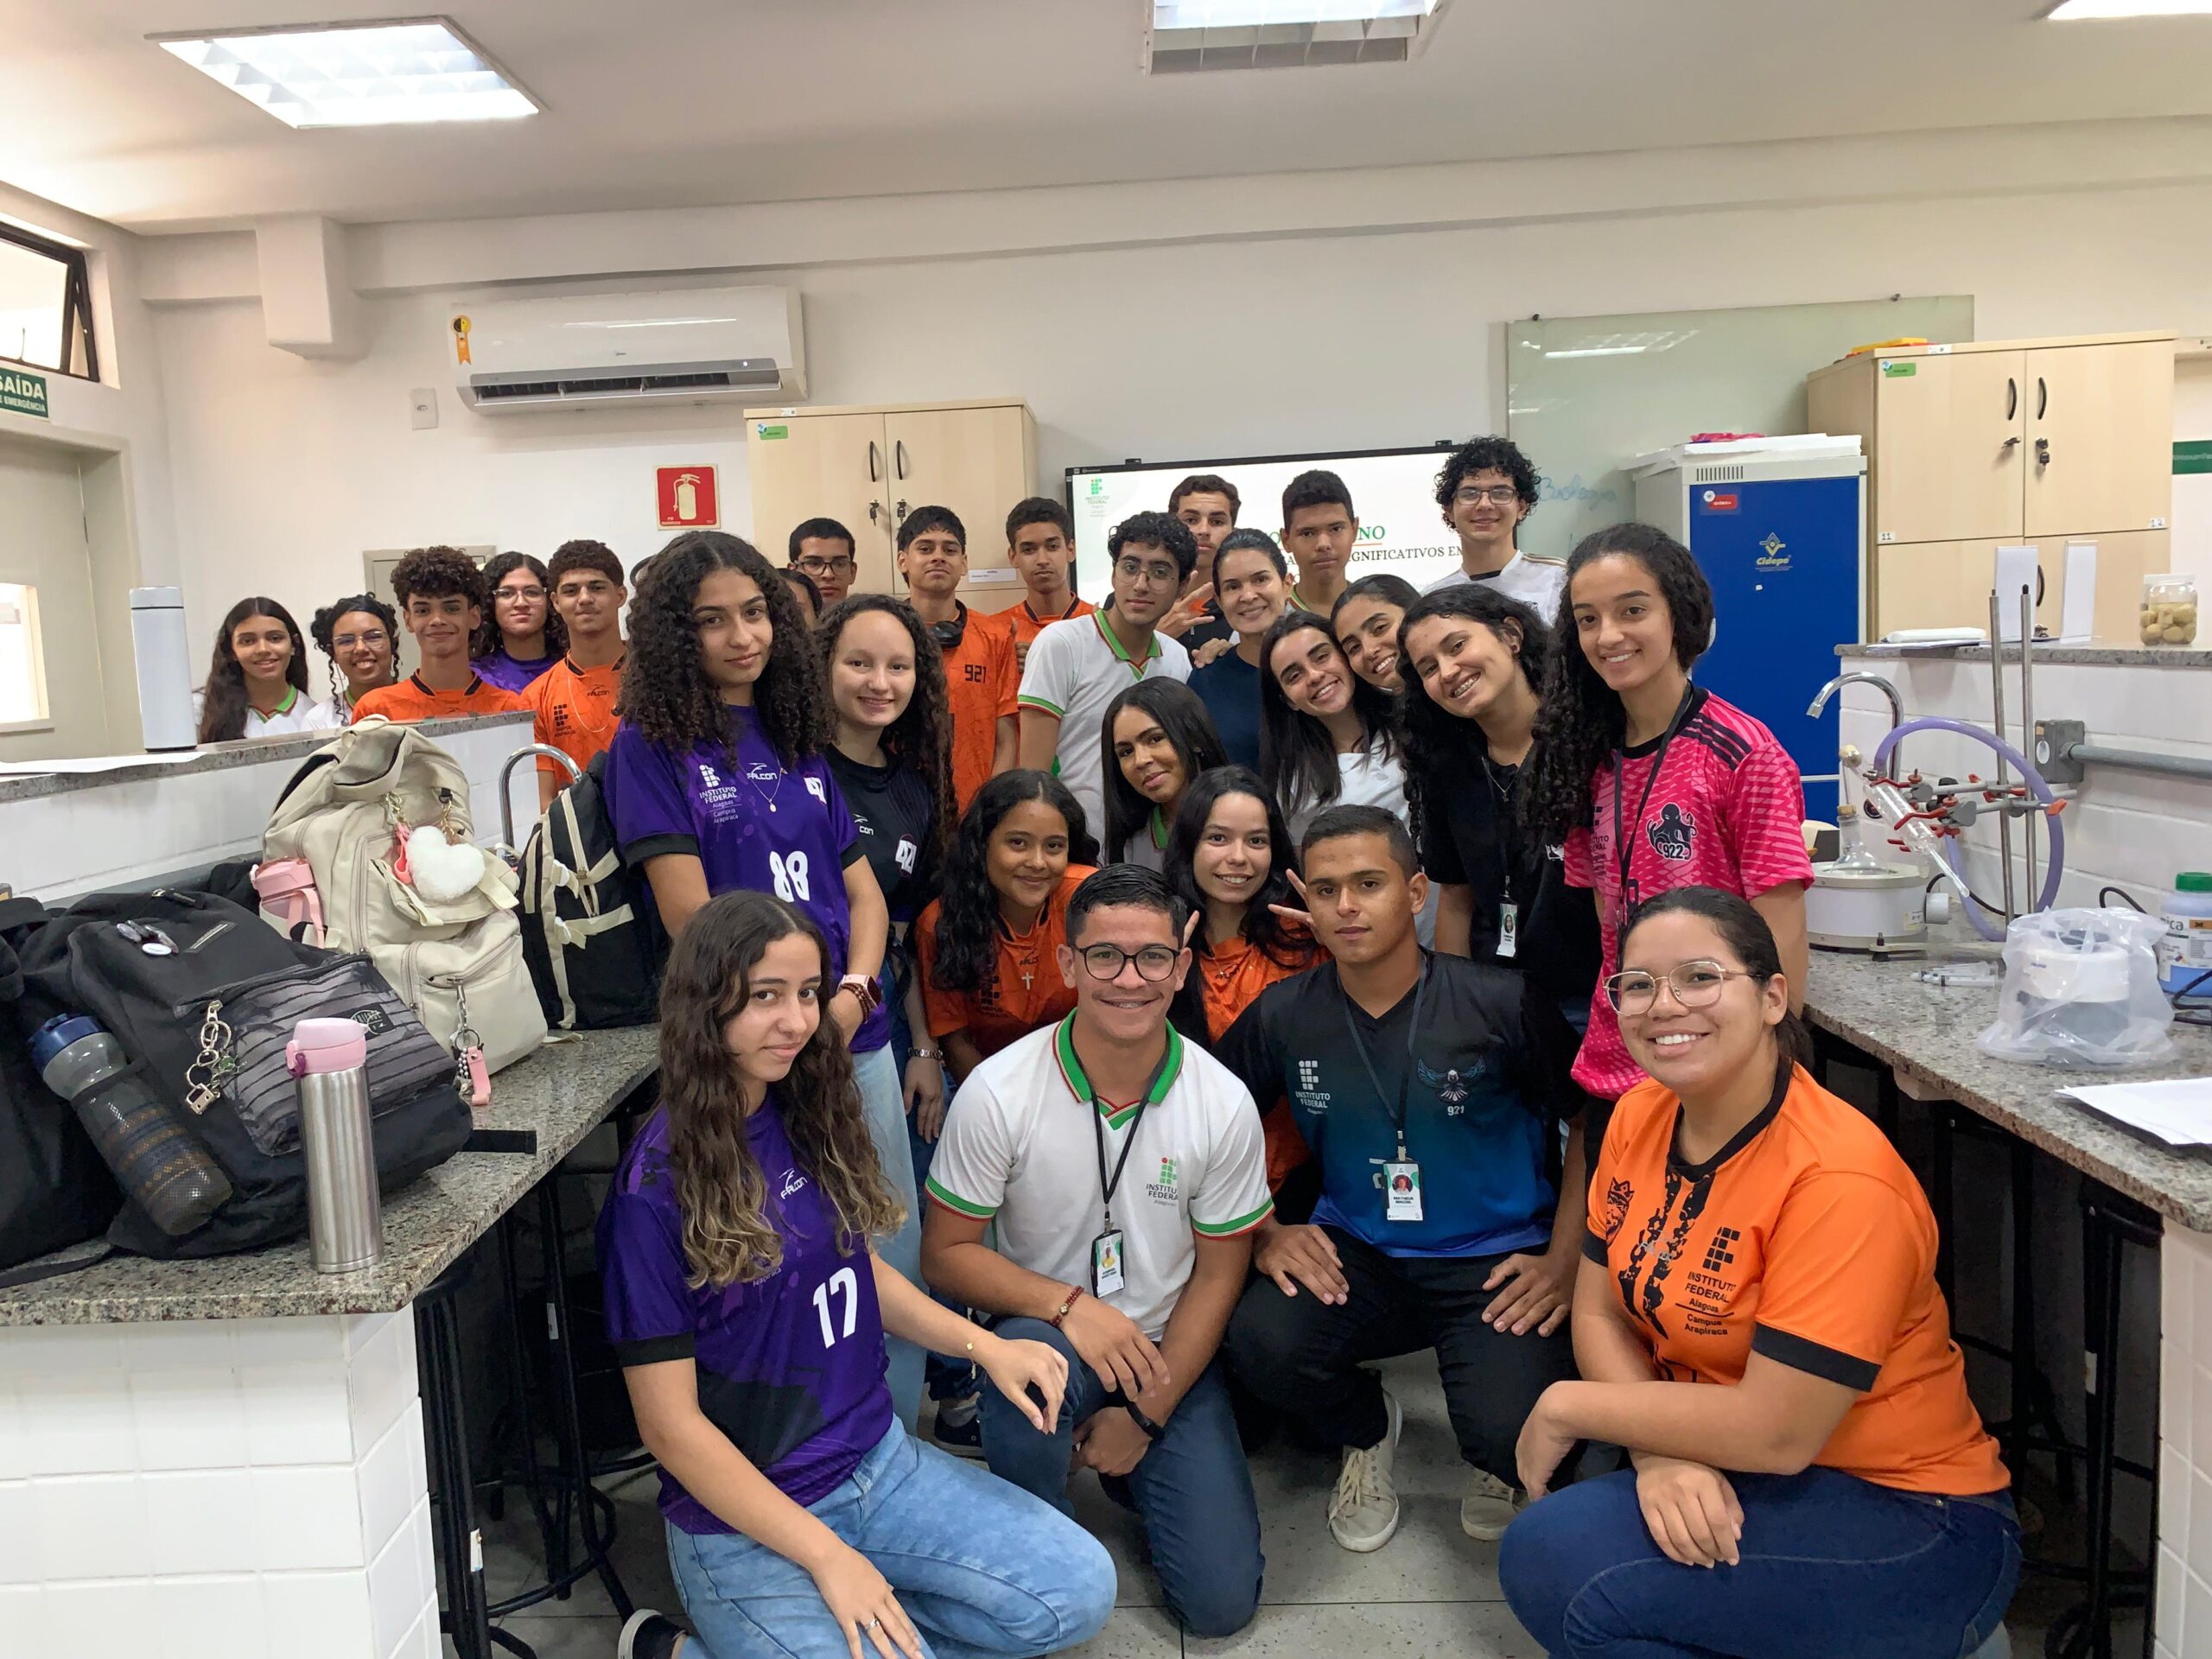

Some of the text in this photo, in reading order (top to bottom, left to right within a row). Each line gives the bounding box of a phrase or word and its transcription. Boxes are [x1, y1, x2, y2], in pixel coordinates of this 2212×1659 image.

[1349, 546, 1445, 562] GNIFICATIVOS
[964, 664, 987, 684] 921
[699, 786, 737, 799] INSTITUTO
[704, 792, 738, 804] FEDERAL
[1663, 843, 1684, 859] 922
[769, 850, 810, 903] 88
[1295, 1090, 1331, 1101] INSTITUTO
[1300, 1098, 1328, 1109] FEDERAL
[1447, 1105, 1465, 1116] 921
[1146, 1183, 1177, 1194] INSTITU
[1148, 1190, 1179, 1201] FEDERA
[1687, 1271, 1737, 1292] INSTITUTO
[1684, 1282, 1730, 1303] FEDERAL
[812, 1267, 858, 1350] 17
[1689, 1298, 1719, 1313] Alagoas
[1687, 1313, 1722, 1325] Campus
[1684, 1323, 1728, 1336] Arapiraca
